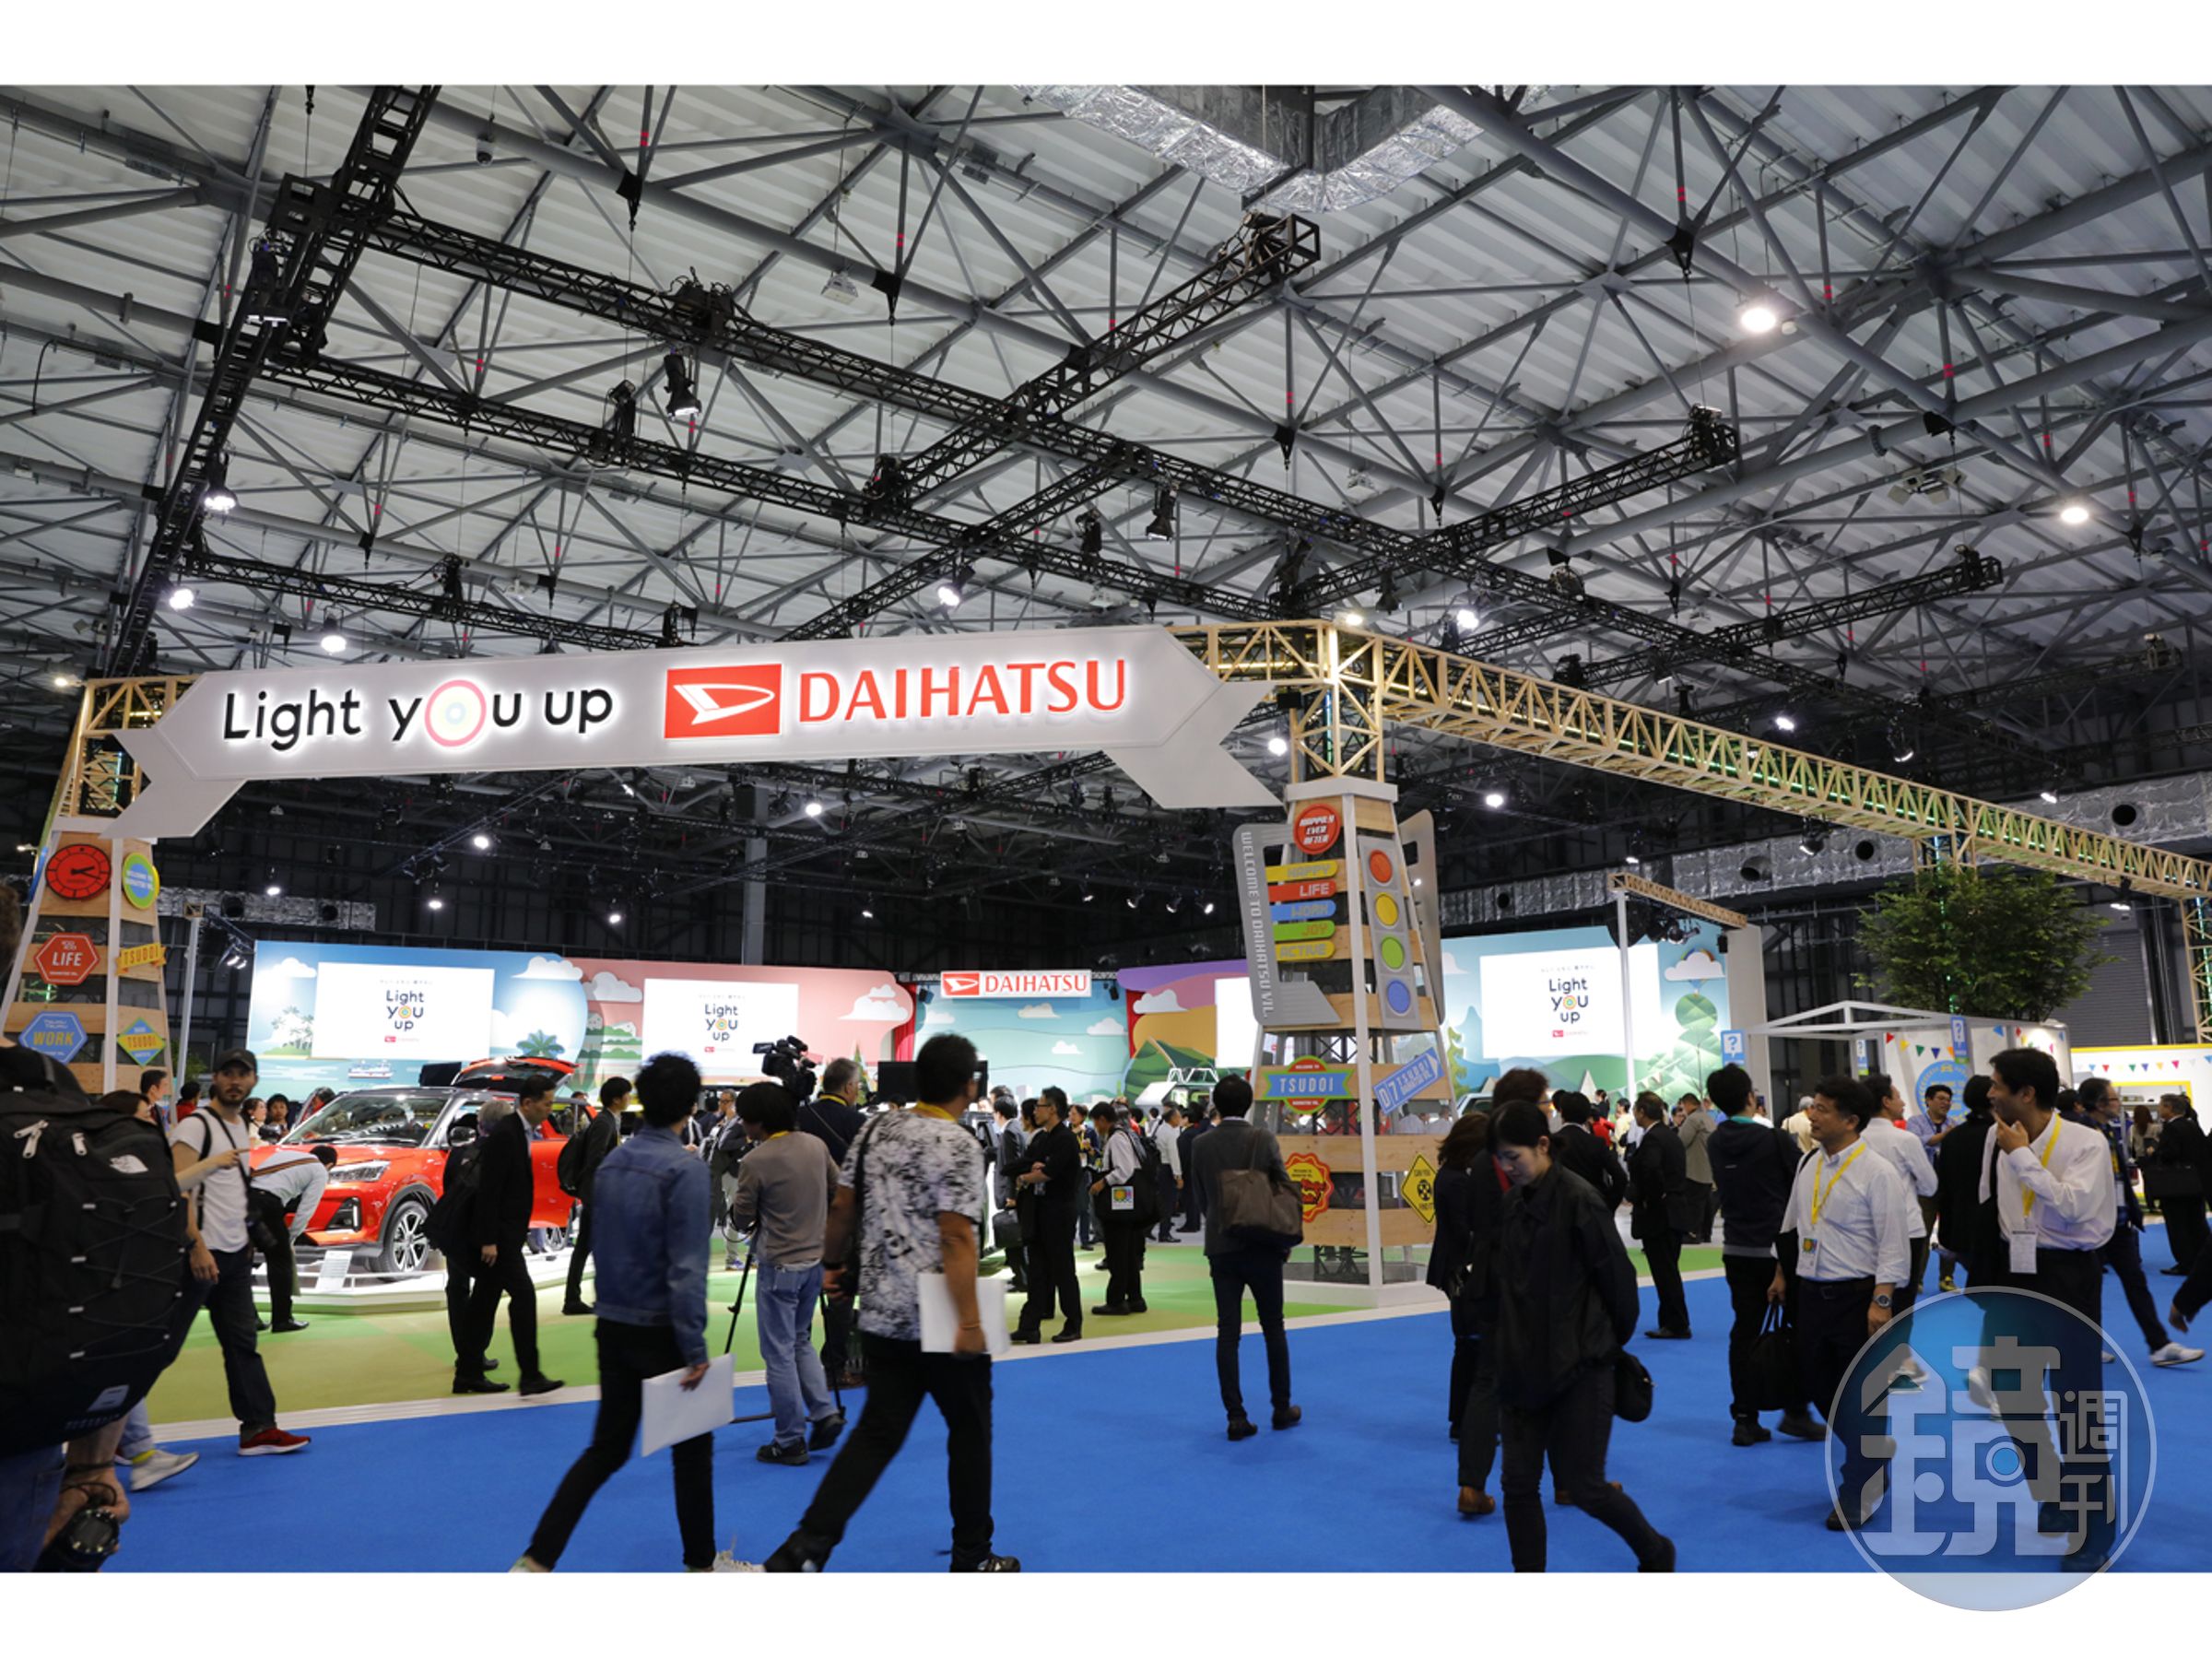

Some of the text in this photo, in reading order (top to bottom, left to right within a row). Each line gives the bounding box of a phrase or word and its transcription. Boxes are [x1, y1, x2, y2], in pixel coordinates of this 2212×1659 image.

[799, 659, 1125, 723] DAIHATSU
[224, 688, 361, 751] Light
[545, 688, 614, 735] up
[1241, 831, 1260, 899] WELCOME
[1287, 864, 1331, 878] HAPPY
[1300, 882, 1330, 897] LIFE
[1250, 900, 1262, 917] TO
[1291, 904, 1329, 917] WORK
[1302, 924, 1329, 936] JOY
[1253, 921, 1272, 989] DAIHATSU
[1280, 943, 1327, 959] ACTIVE
[52, 952, 83, 967] LIFE
[985, 974, 1087, 993] DAIHATSU
[1549, 978, 1588, 994] Light
[386, 989, 424, 1006] Light
[705, 1003, 738, 1018] Light
[1560, 1012, 1581, 1024] up
[394, 1020, 414, 1031] up
[33, 1031, 75, 1047] WORK
[712, 1031, 730, 1041] up
[1279, 1077, 1334, 1093] TSUDOI
